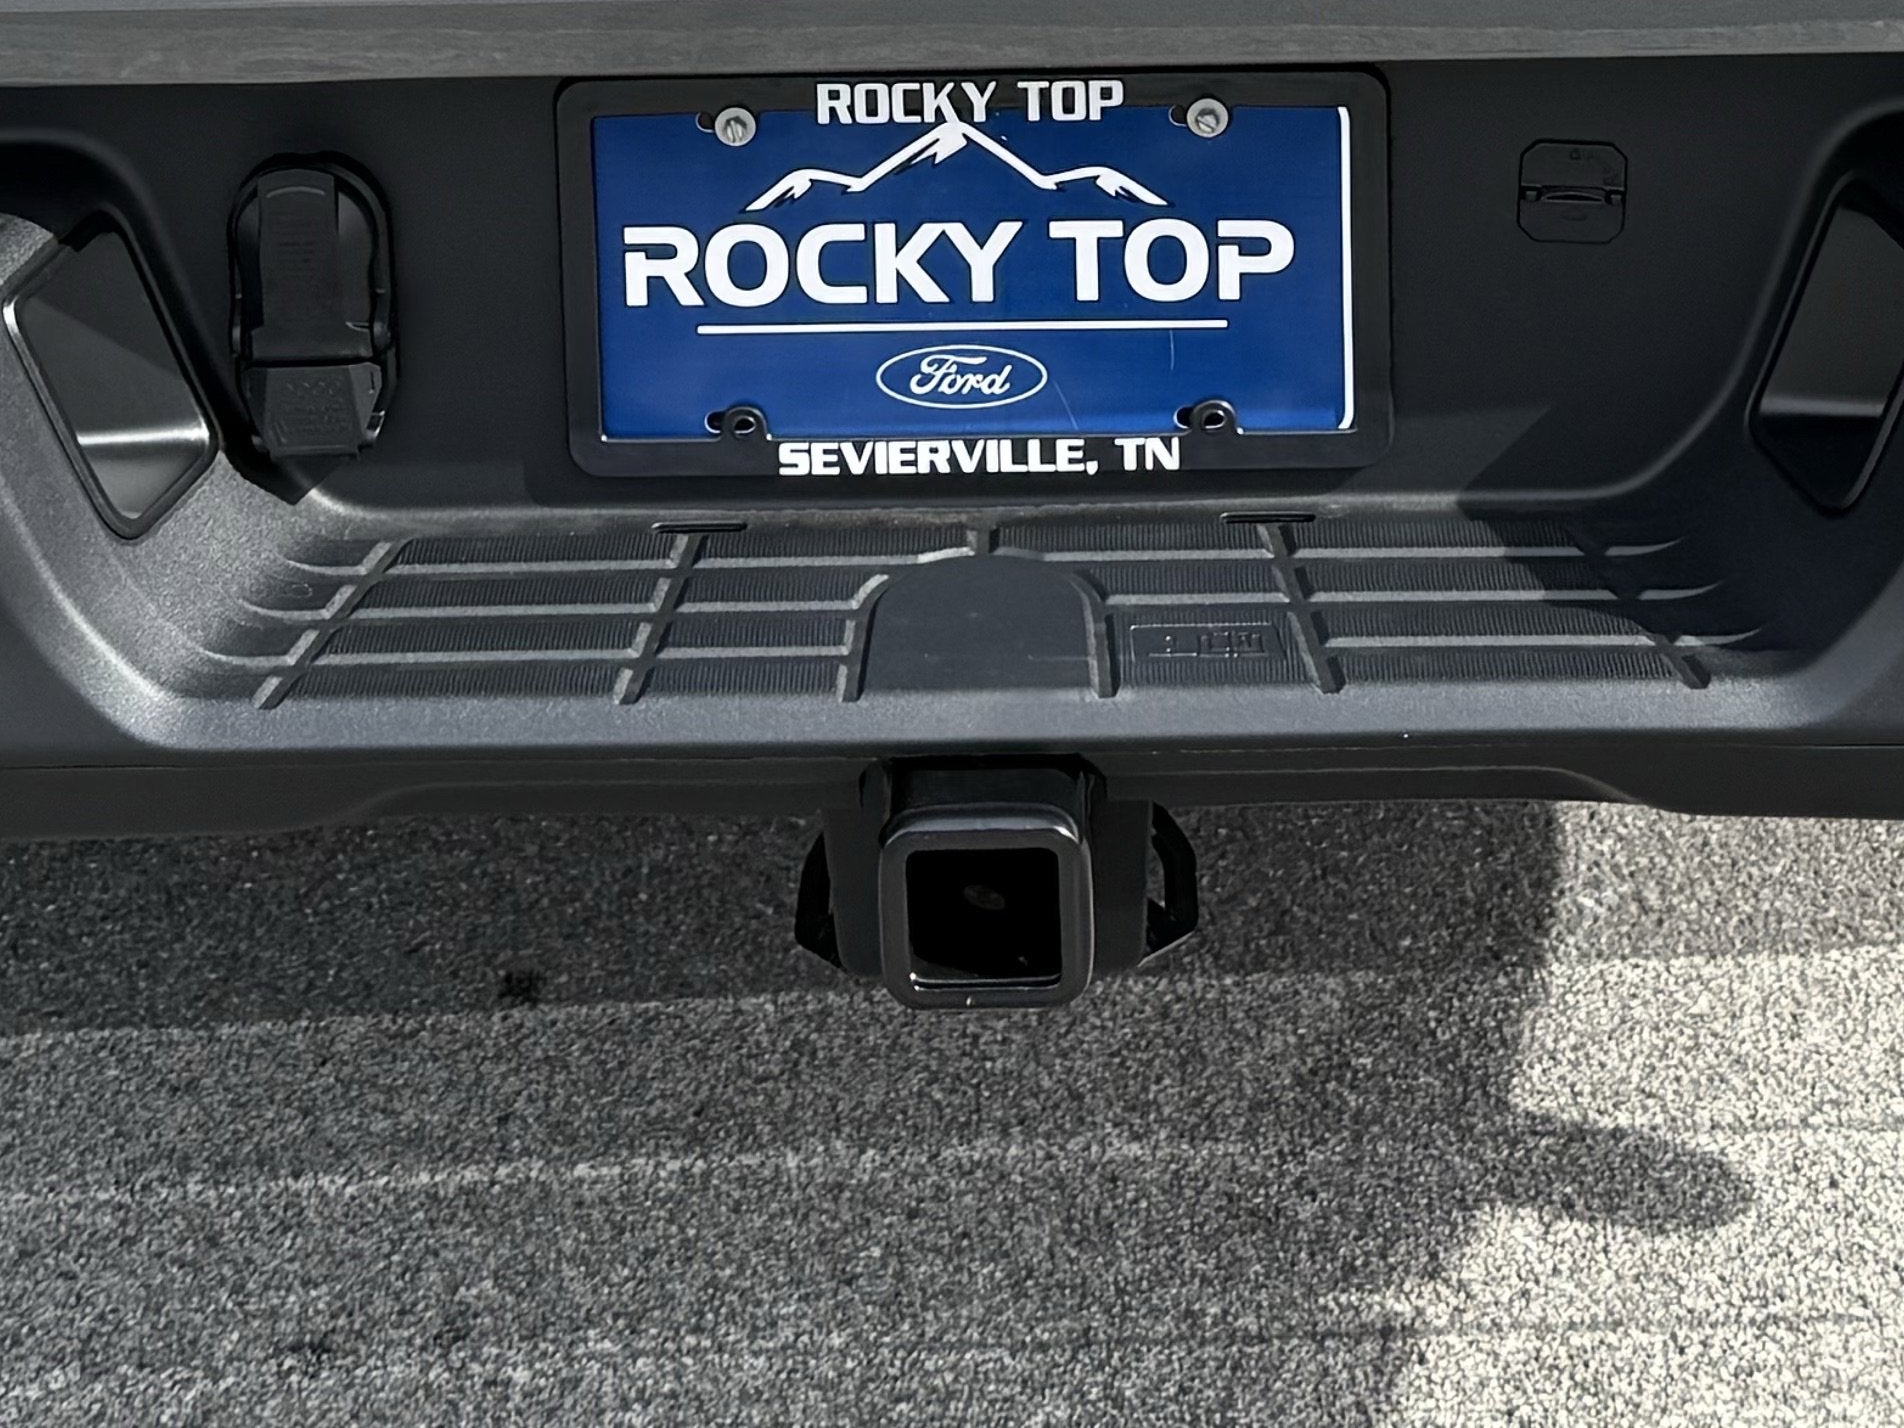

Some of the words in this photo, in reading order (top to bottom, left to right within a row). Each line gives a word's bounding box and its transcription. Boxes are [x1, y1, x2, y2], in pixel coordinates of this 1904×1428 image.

[816, 81, 996, 124] ROCKY
[1017, 80, 1124, 122] TOP
[623, 221, 1023, 307] ROCKY
[1049, 218, 1295, 302] TOP
[909, 354, 1013, 396] Ford
[778, 438, 1099, 476] SEVIERVILLE,
[1114, 437, 1180, 471] TN
